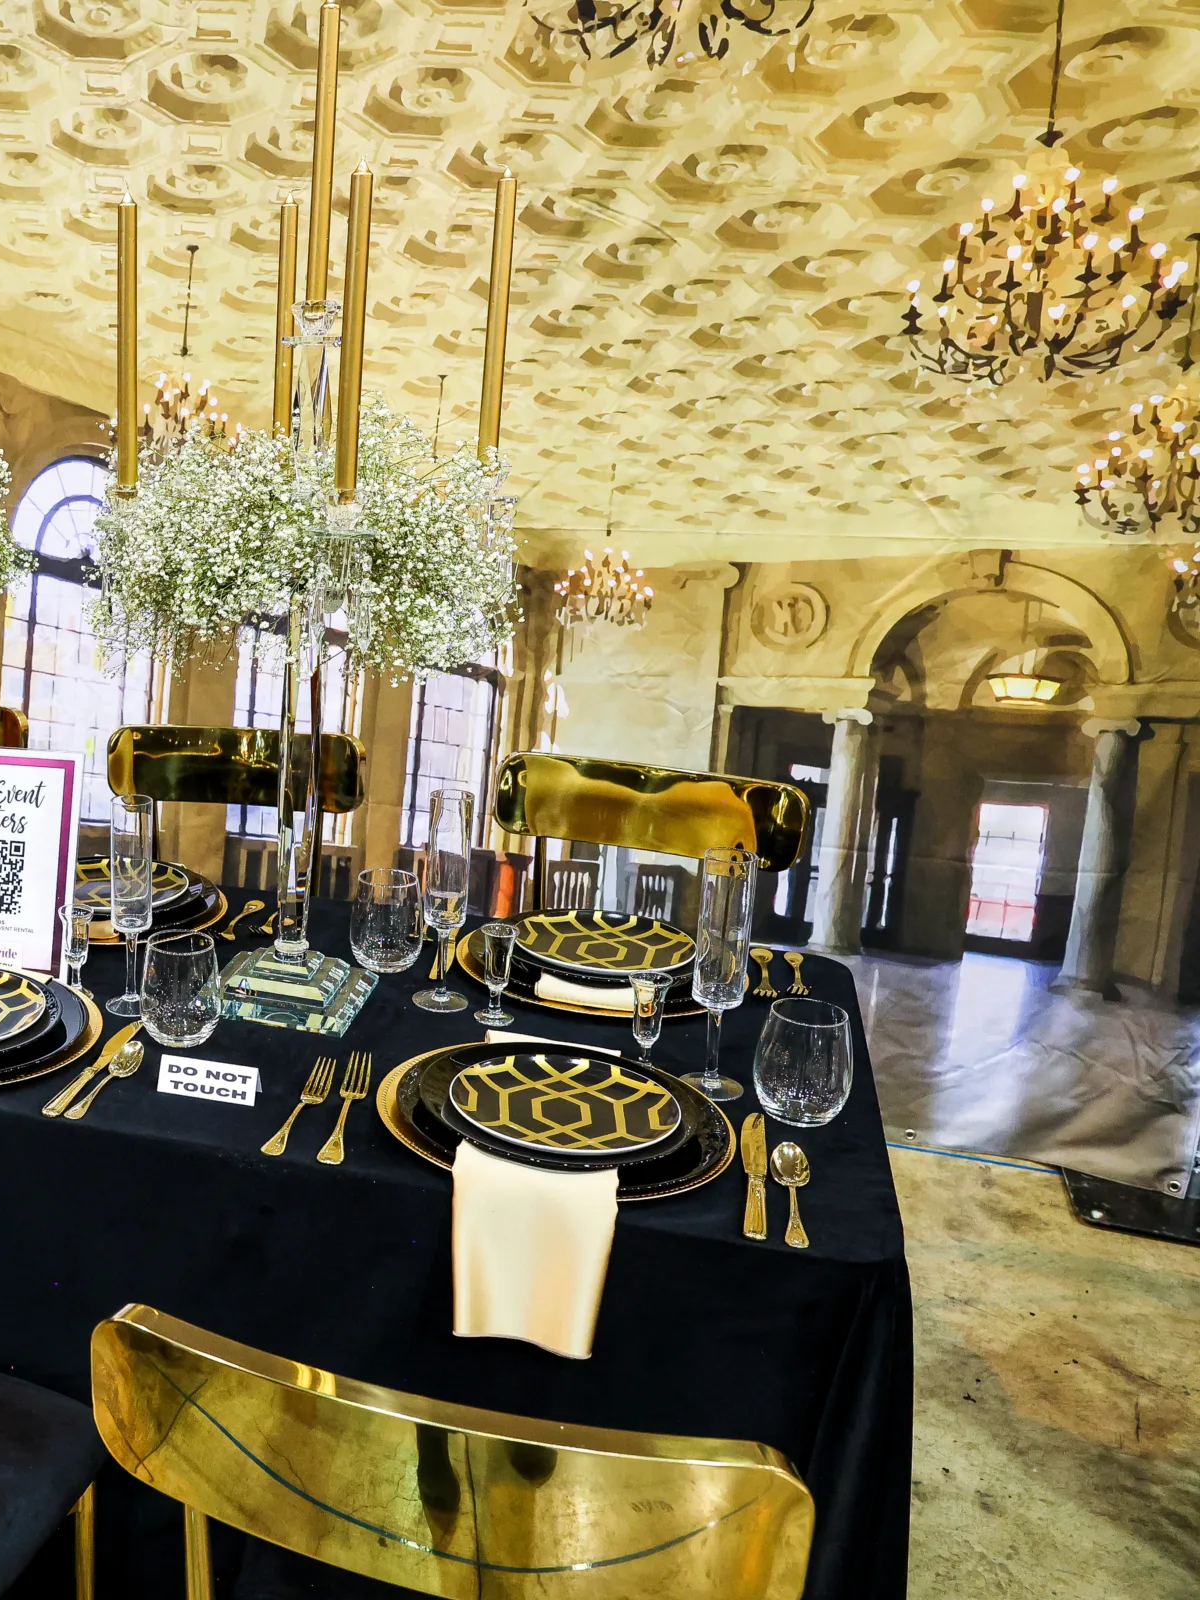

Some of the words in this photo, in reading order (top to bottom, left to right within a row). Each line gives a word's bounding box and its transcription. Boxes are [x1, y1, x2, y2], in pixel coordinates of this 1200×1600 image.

[13, 926, 34, 934] RENTAL
[168, 1064, 198, 1076] DO
[205, 1070, 252, 1085] NOT
[170, 1080, 247, 1100] TOUCH
